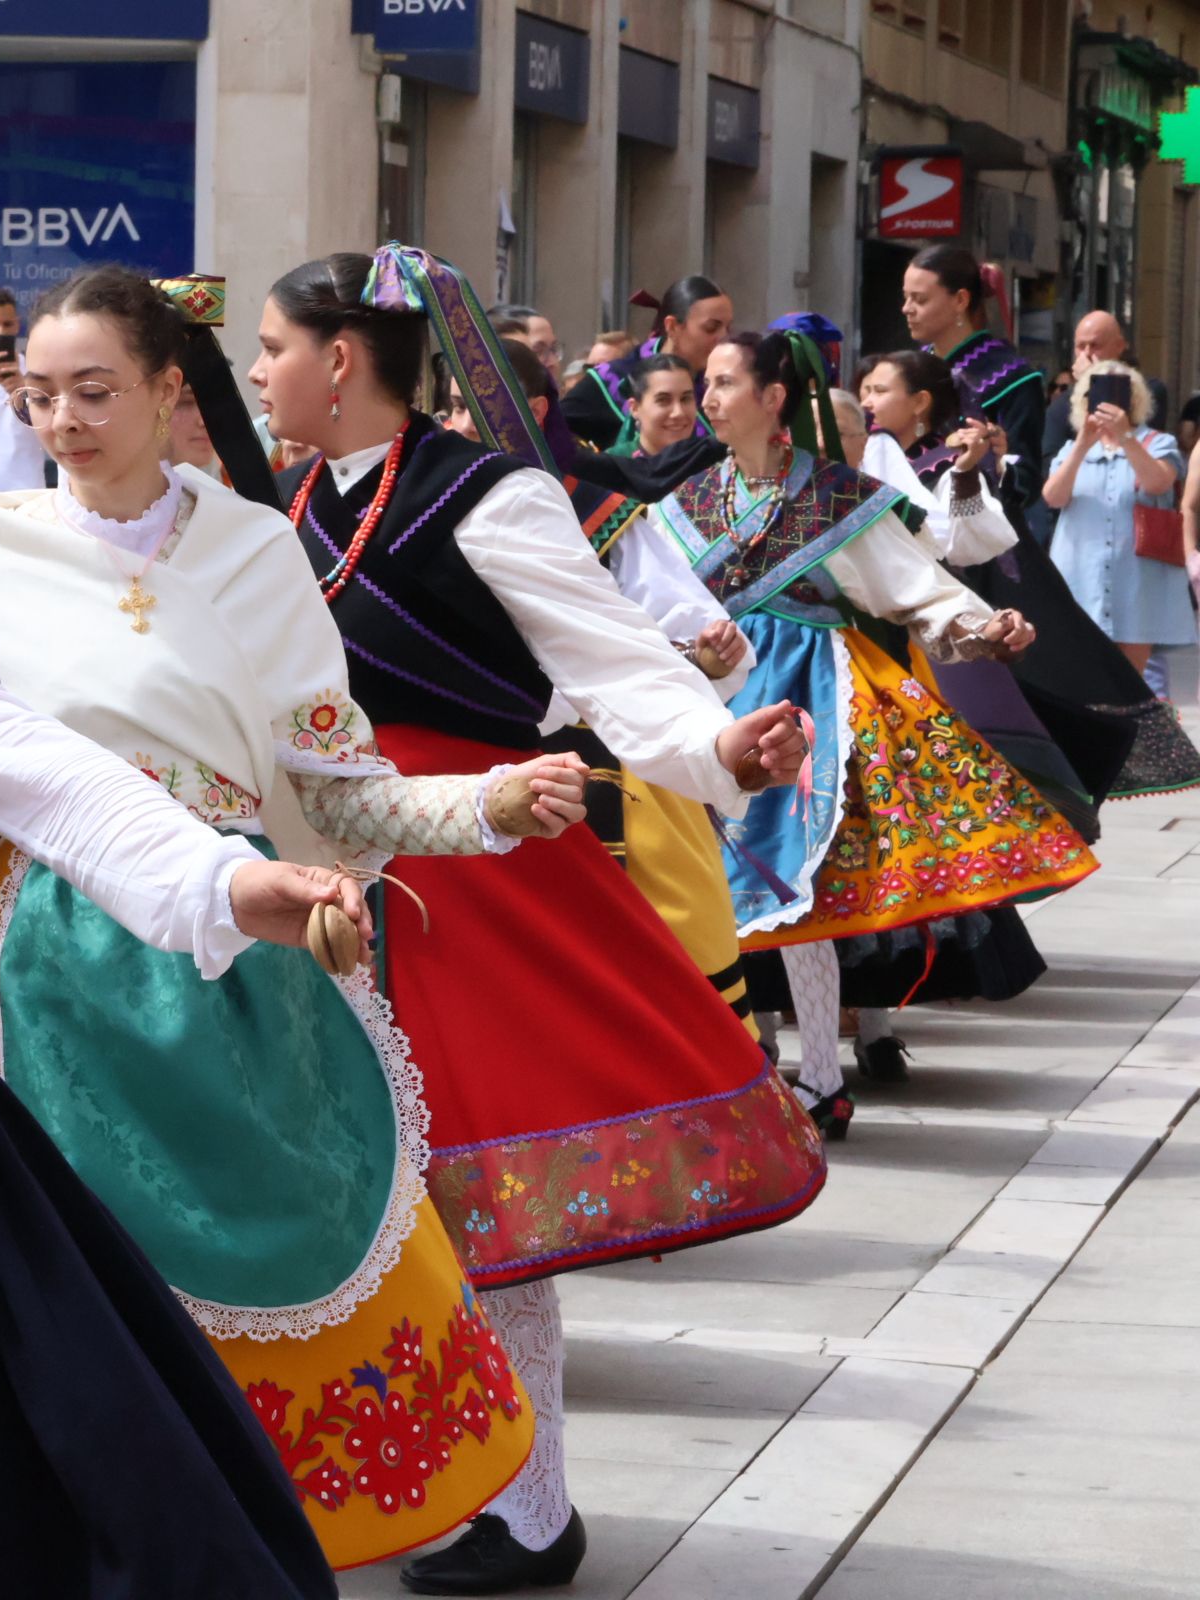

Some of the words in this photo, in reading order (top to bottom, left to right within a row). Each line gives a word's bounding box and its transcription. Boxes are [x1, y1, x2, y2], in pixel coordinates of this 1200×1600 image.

[529, 41, 562, 90] BBVA
[2, 202, 141, 247] BBVA
[3, 264, 21, 279] Tu
[26, 263, 73, 279] Oficin
